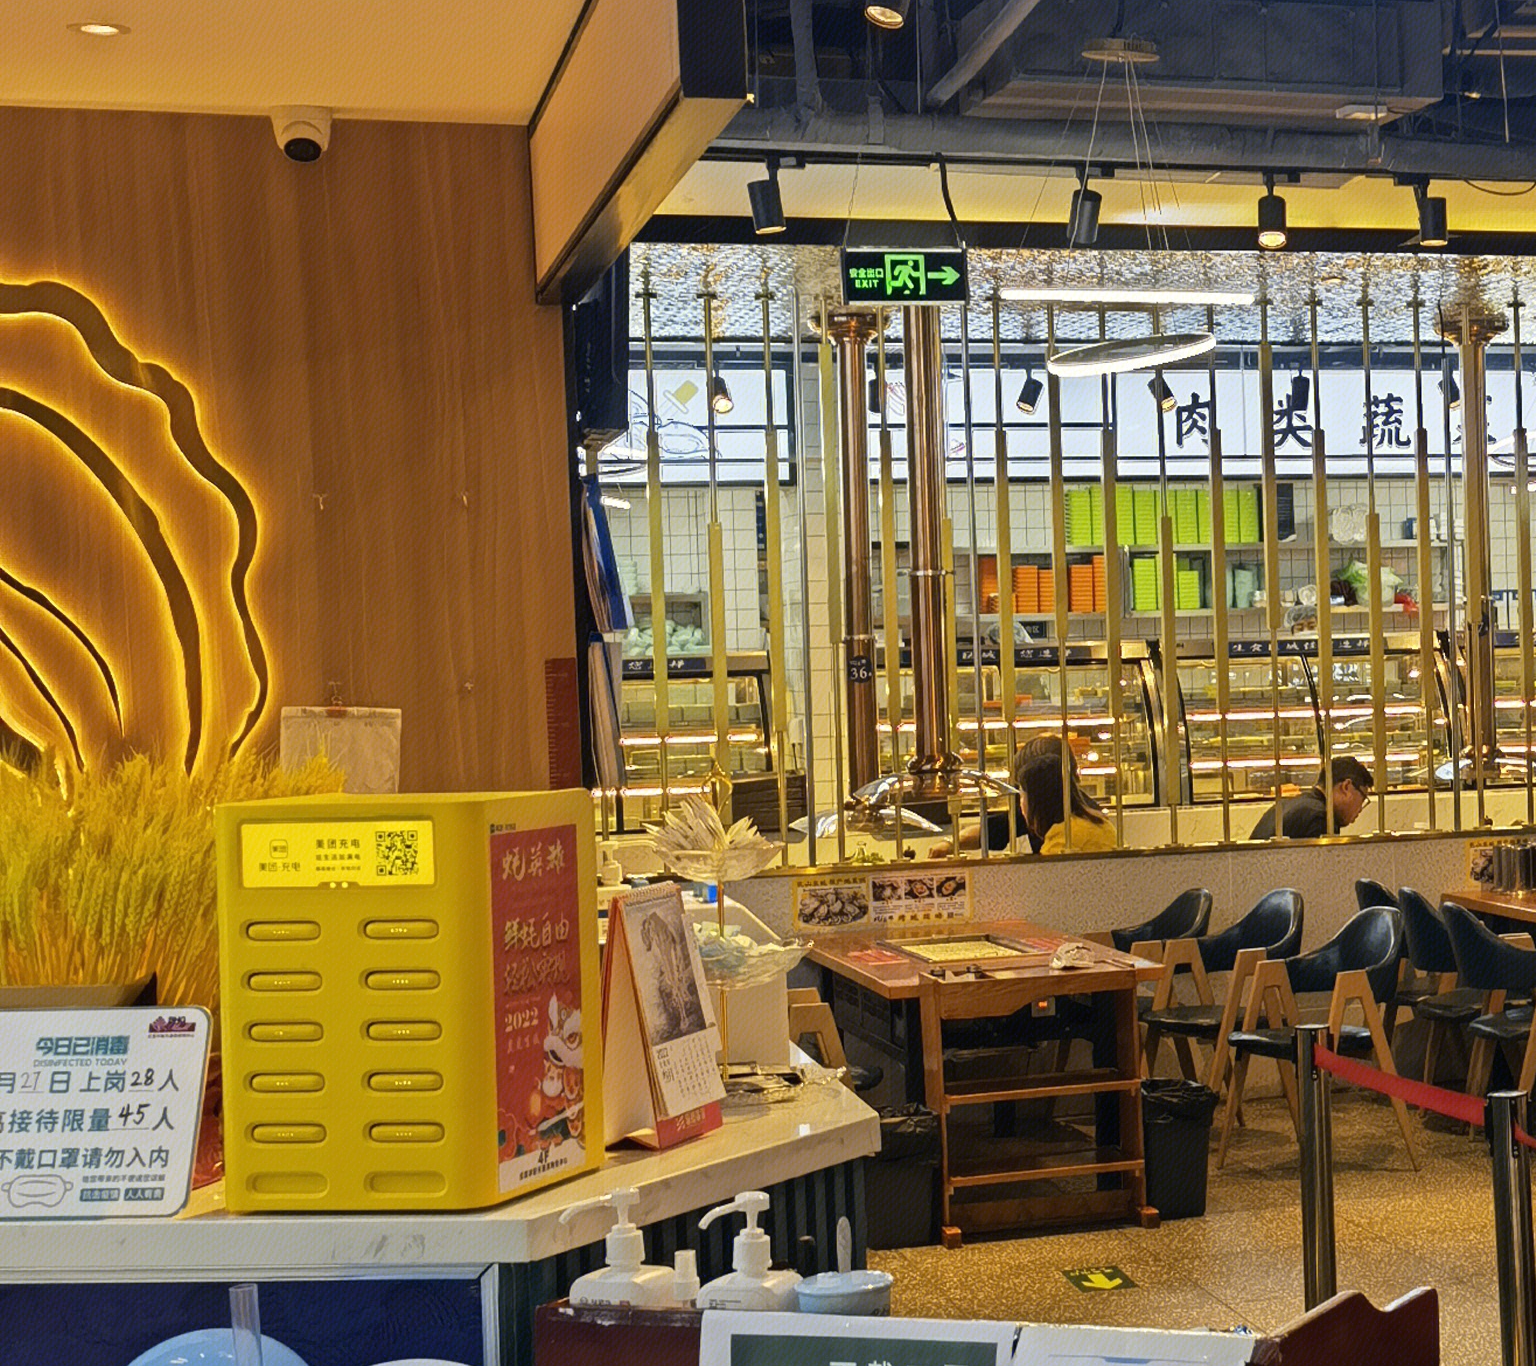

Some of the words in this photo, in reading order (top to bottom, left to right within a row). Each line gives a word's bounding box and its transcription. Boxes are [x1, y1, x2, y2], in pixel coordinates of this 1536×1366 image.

[855, 279, 879, 288] EXIT
[850, 667, 868, 680] 36
[315, 838, 361, 849] 美团充电
[504, 1006, 539, 1032] 2022
[35, 1035, 130, 1057] 今日已消毒
[95, 1058, 128, 1066] TODAY
